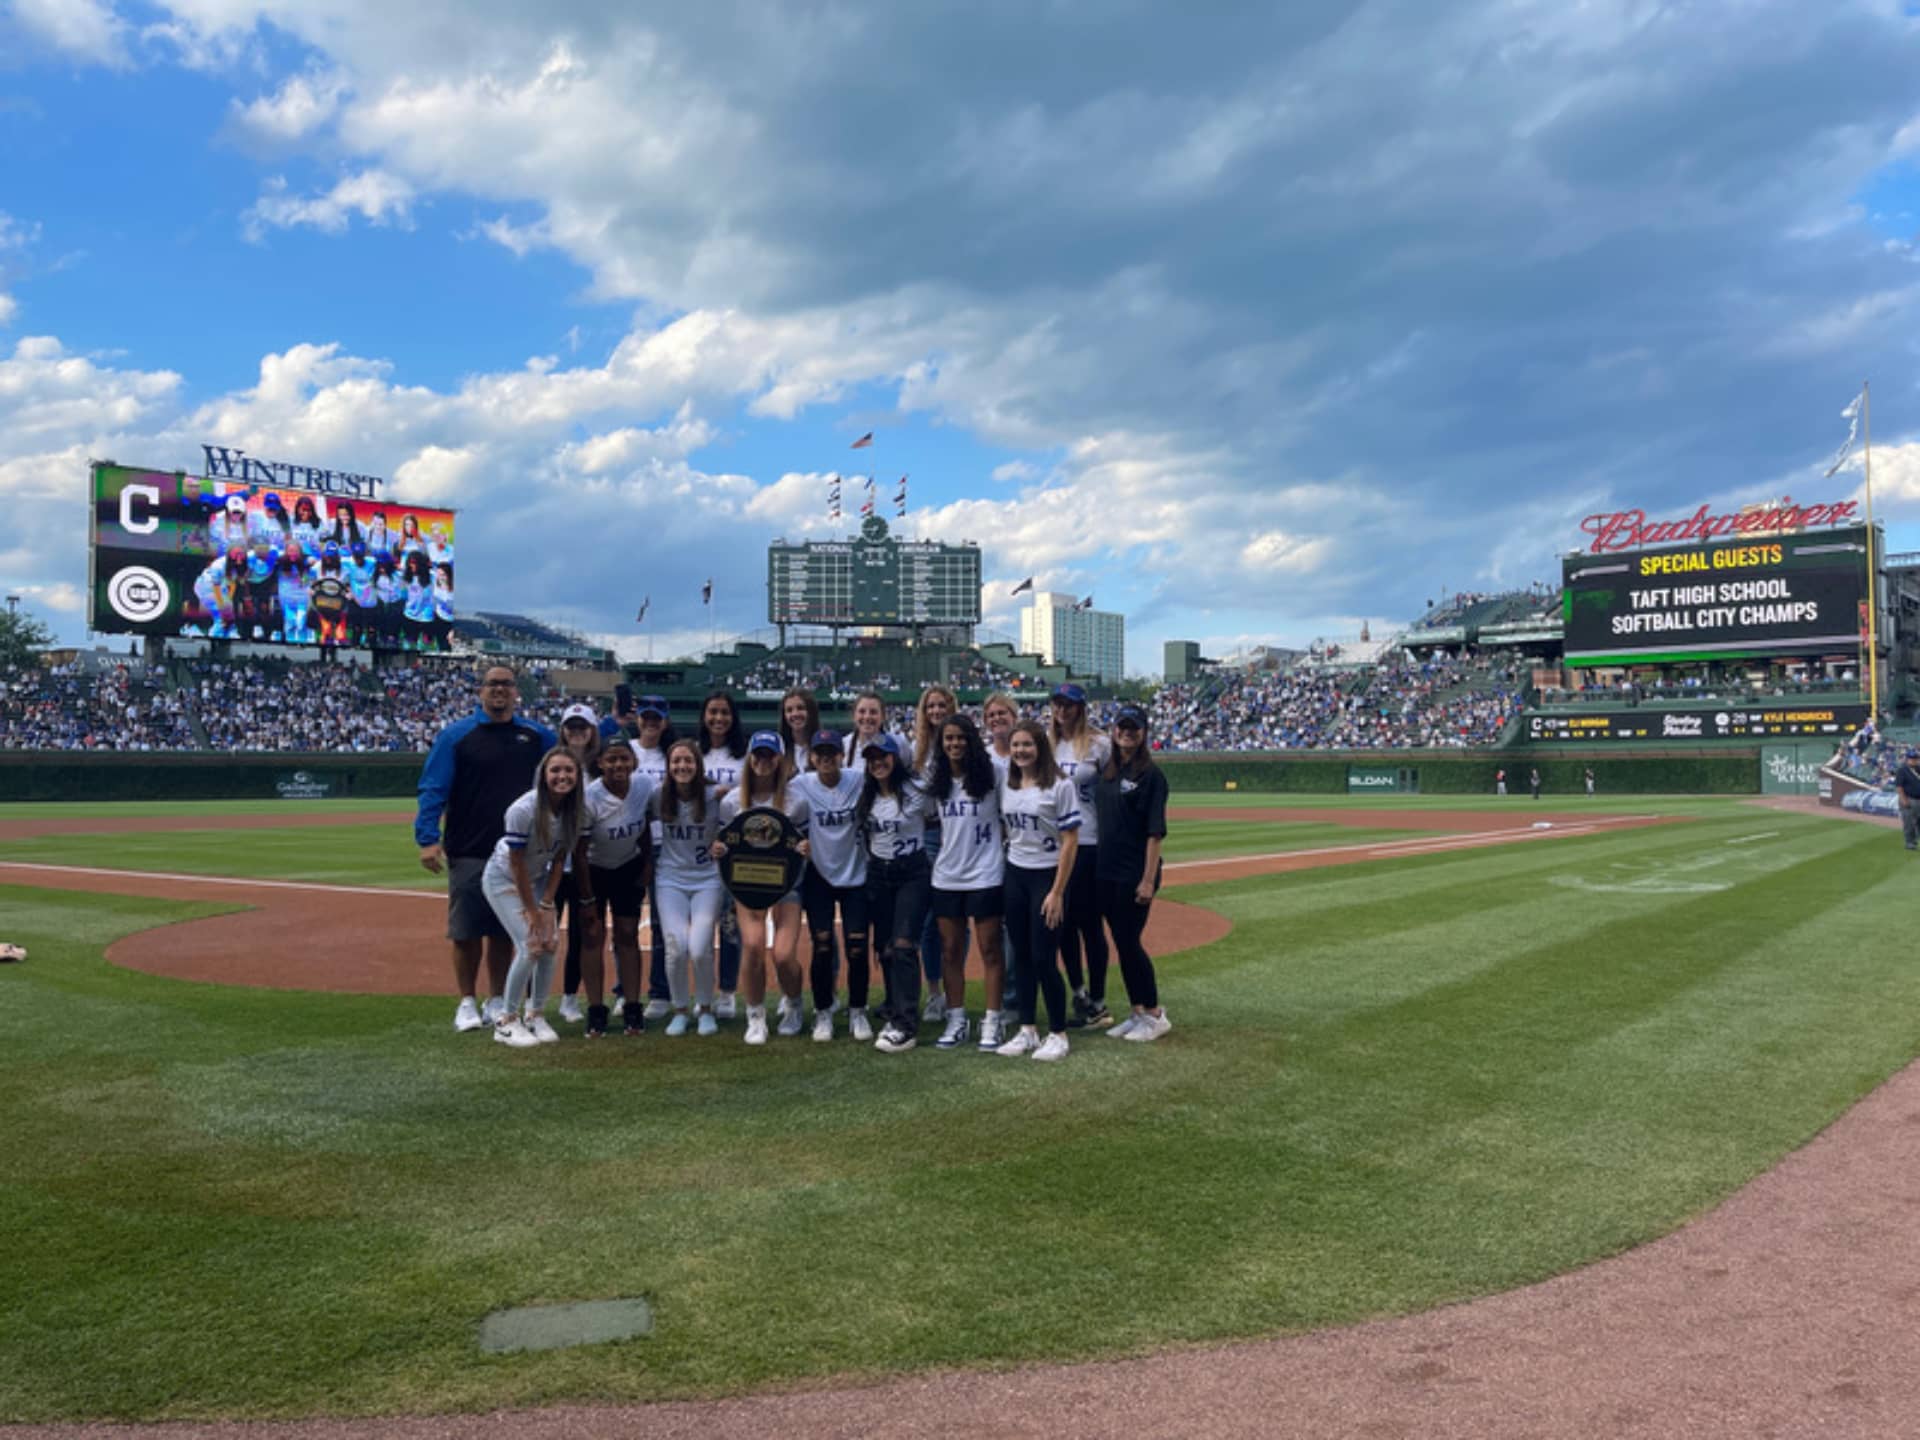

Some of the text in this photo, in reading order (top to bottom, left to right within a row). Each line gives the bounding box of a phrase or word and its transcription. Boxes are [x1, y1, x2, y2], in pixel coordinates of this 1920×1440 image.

[119, 484, 160, 533] C
[1580, 496, 1858, 552] Budweiser
[1640, 544, 1783, 575] SPECIAL GUESTS
[1629, 578, 1791, 610] TAFT HIGH SCHOOL
[1611, 601, 1818, 635] SOFTBALL CITY CHAMPS
[942, 800, 980, 817] TAFT
[608, 820, 643, 840] TAFT
[667, 824, 706, 840] TAFT
[1006, 813, 1040, 831] TAFT
[975, 823, 992, 845] 14
[893, 838, 918, 858] 27
